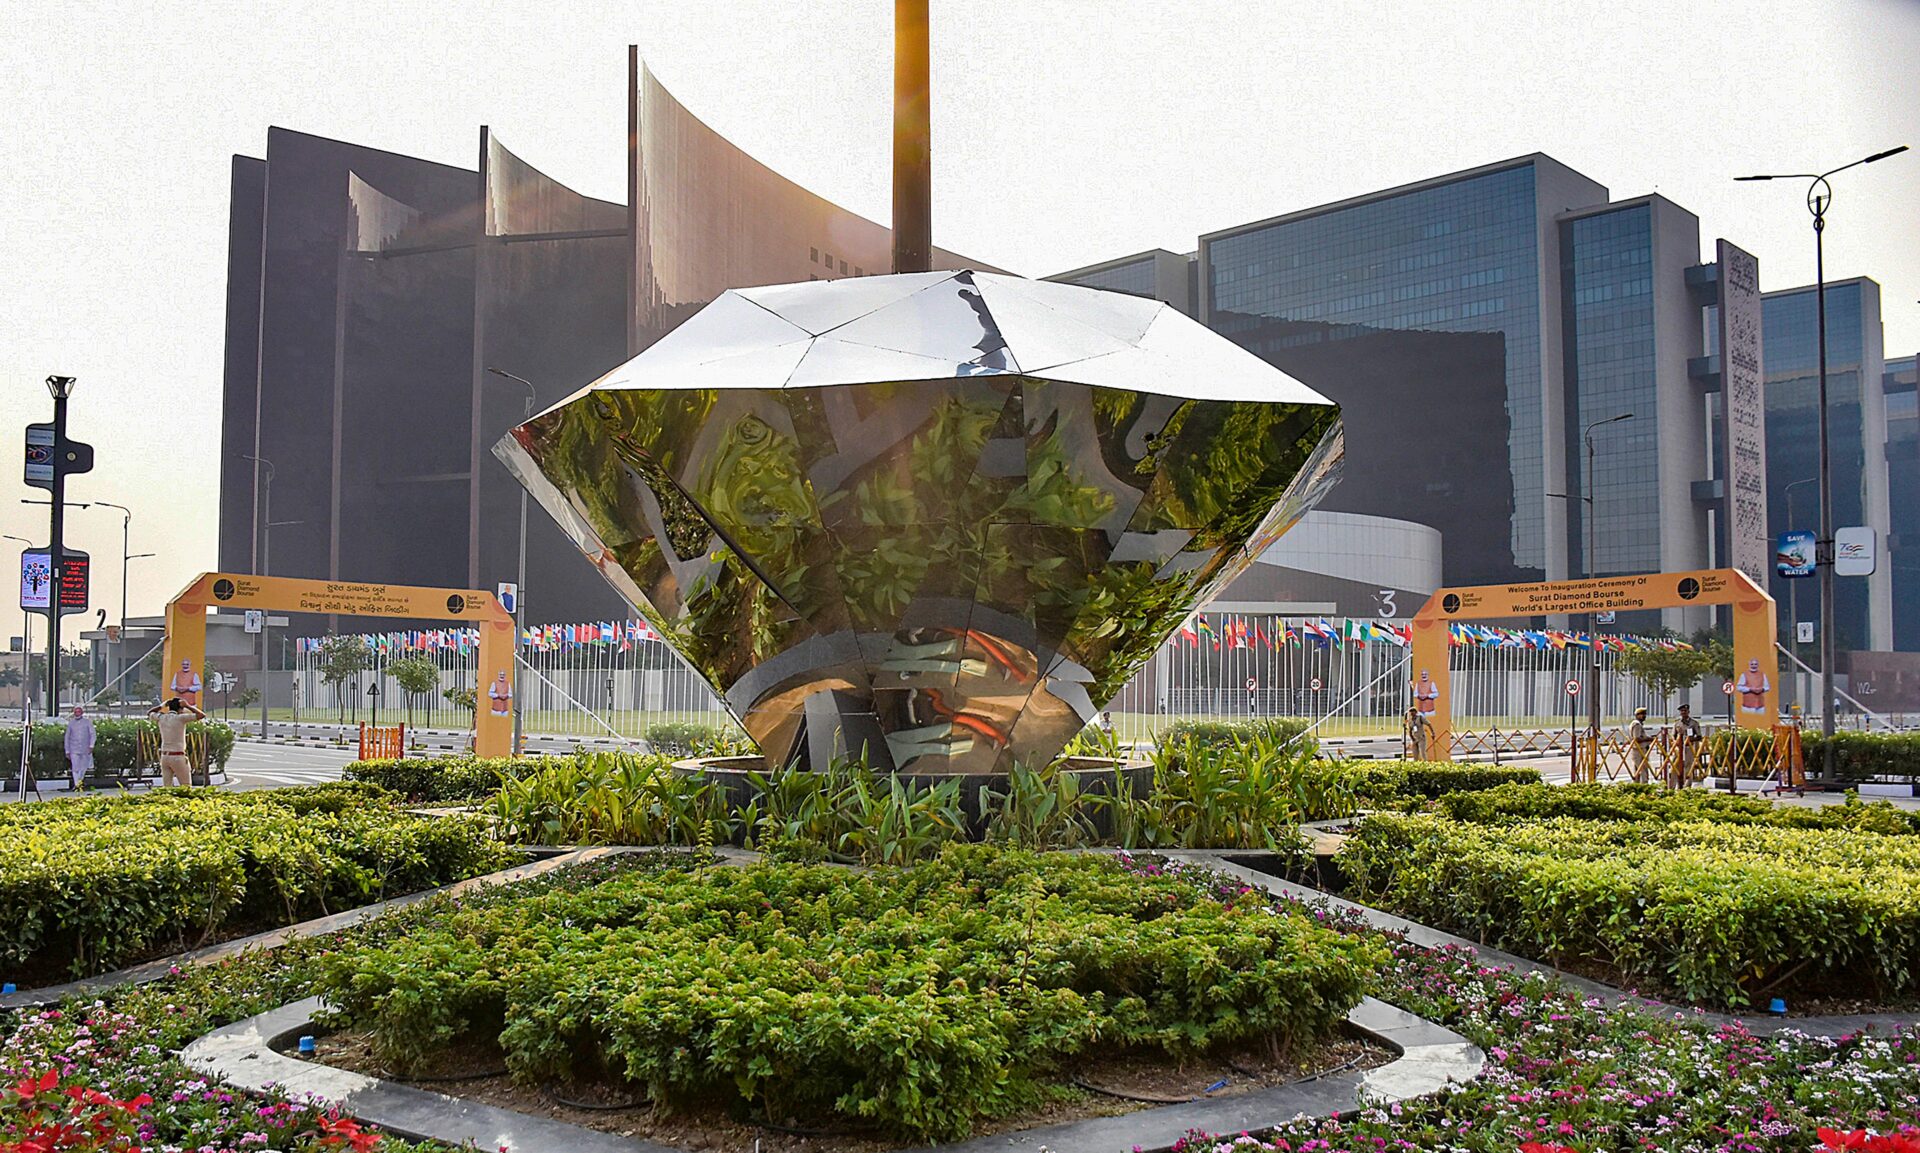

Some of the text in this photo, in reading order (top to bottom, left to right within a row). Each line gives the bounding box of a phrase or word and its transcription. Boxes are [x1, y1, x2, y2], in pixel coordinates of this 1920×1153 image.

[327, 584, 344, 593] સુરત
[347, 585, 370, 593] ડાયમંડ
[1551, 582, 1597, 591] Inauguration
[1598, 580, 1635, 588] Ceremony
[1529, 591, 1624, 602] Surat Diamond Bourse
[1379, 590, 1397, 618] 3
[1512, 599, 1643, 612] World's Largest Office Building
[97, 608, 107, 631] 2
[1568, 683, 1578, 691] 30
